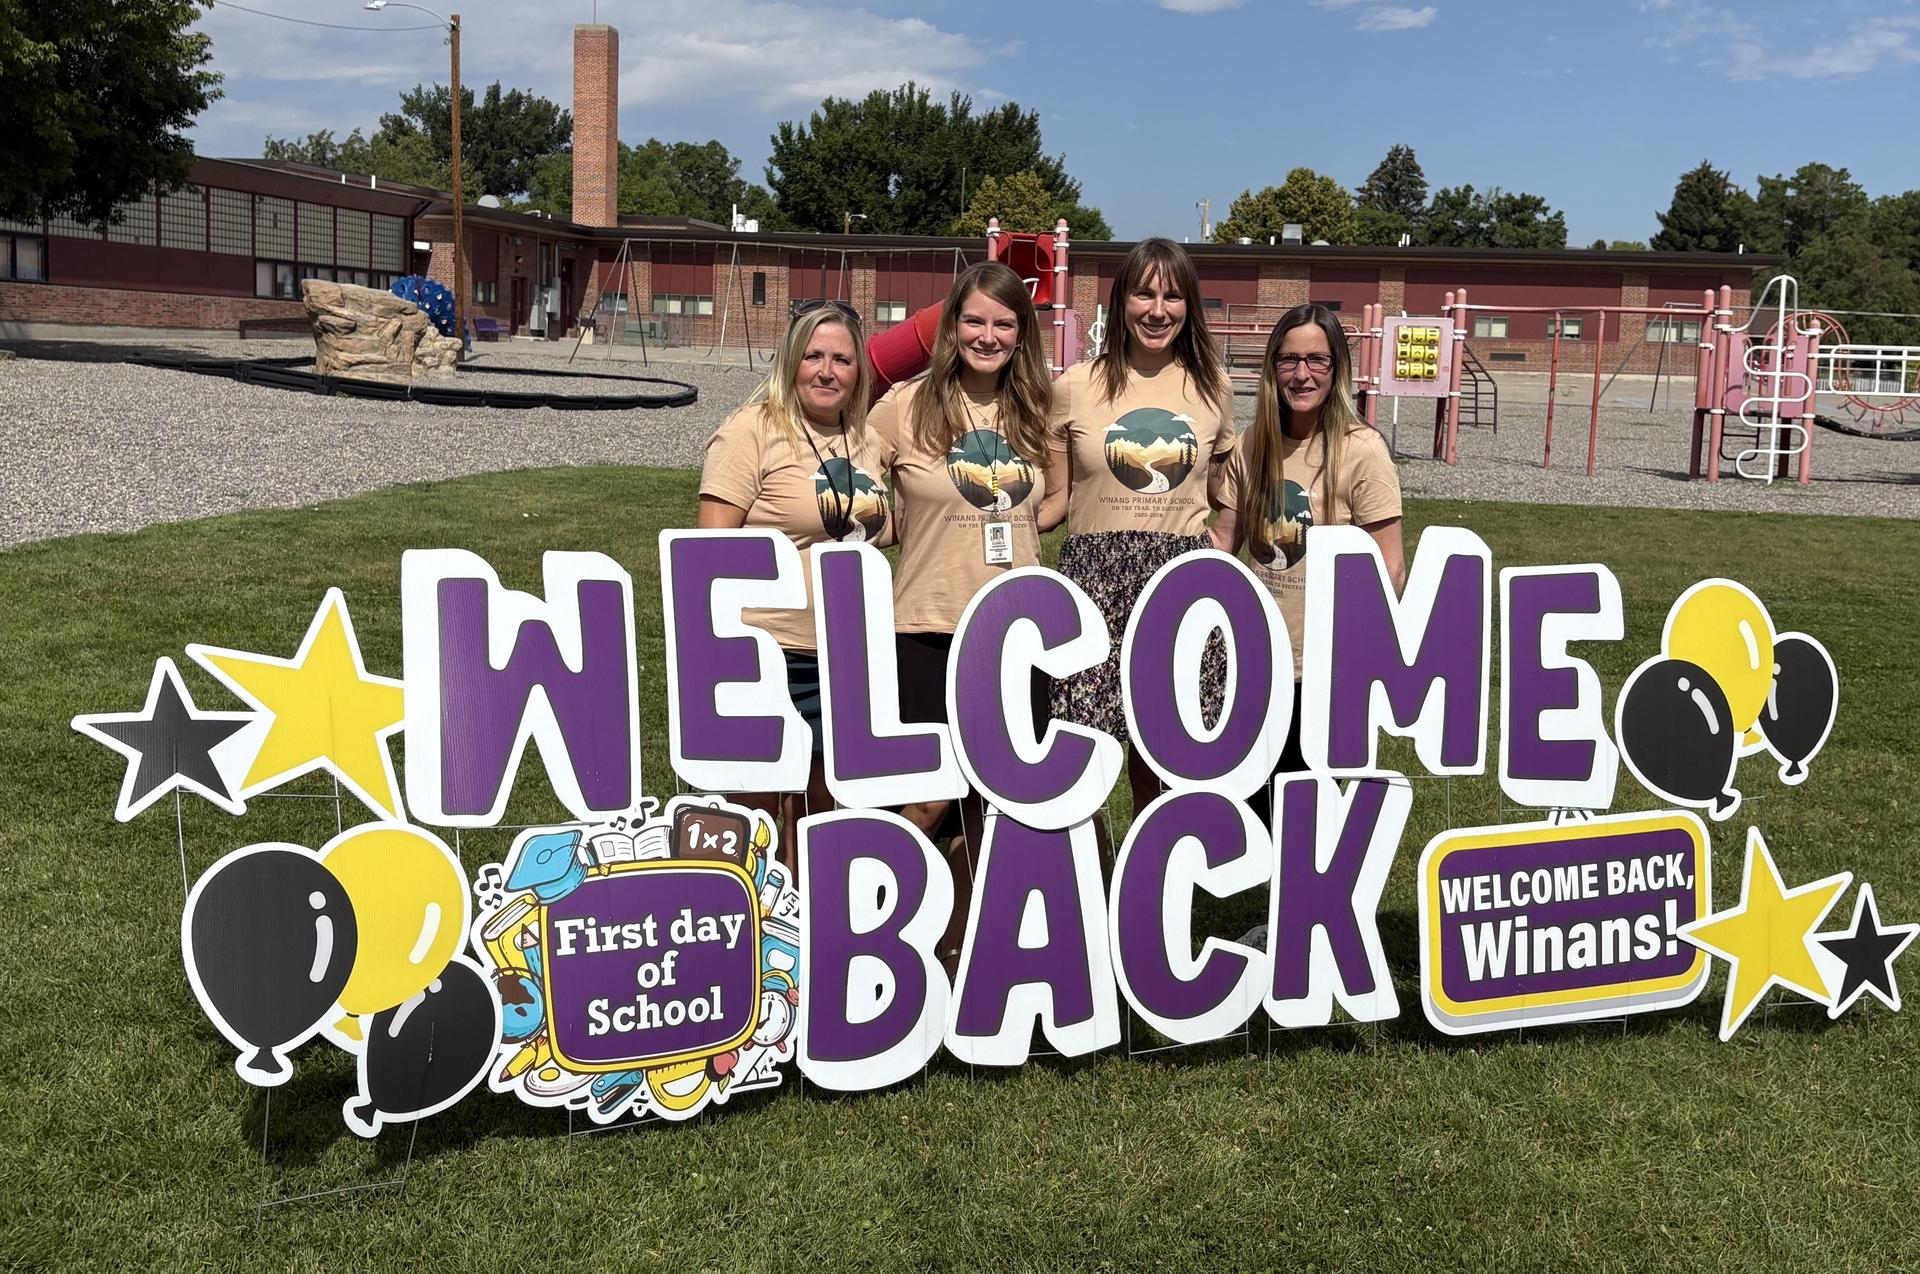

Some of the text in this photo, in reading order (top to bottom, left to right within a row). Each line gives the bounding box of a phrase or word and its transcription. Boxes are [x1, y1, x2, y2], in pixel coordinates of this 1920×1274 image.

[944, 514, 976, 522] WINANS
[978, 514, 1012, 522] PRIRY
[1099, 496, 1196, 505] WINANS PRIMARY SCHOOL
[437, 537, 1602, 816] WELCOME
[1440, 852, 1695, 914] WELCOME BACK,
[554, 908, 746, 956] First day
[808, 779, 1389, 1062] BACK
[1460, 899, 1678, 982] Winans!
[636, 950, 680, 988] of
[587, 985, 725, 1036] School
